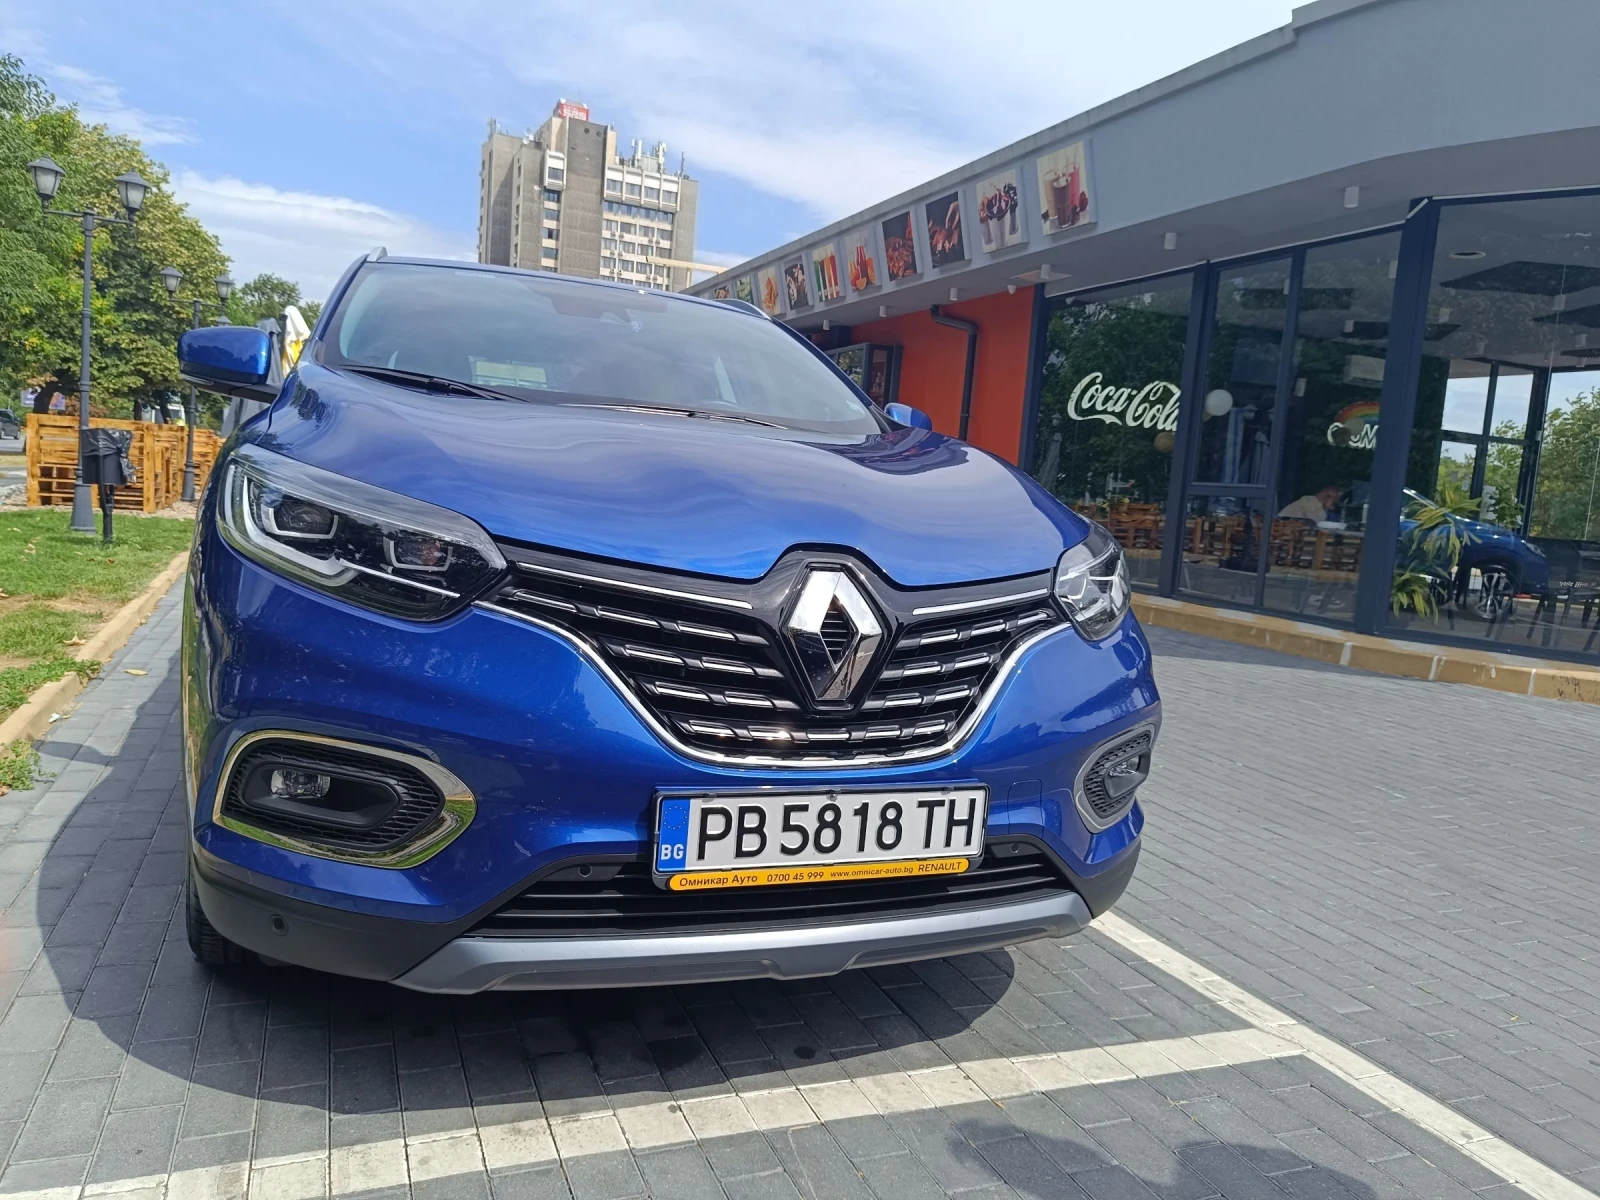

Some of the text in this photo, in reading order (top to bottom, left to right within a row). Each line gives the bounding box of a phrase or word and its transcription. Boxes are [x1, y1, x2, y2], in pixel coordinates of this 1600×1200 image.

[697, 798, 976, 860] PB 5818 TH
[660, 843, 684, 860] BG
[679, 861, 962, 887] Омникар Ауто 0700 45 999 www.omnicar-auto.bg RENAULT
